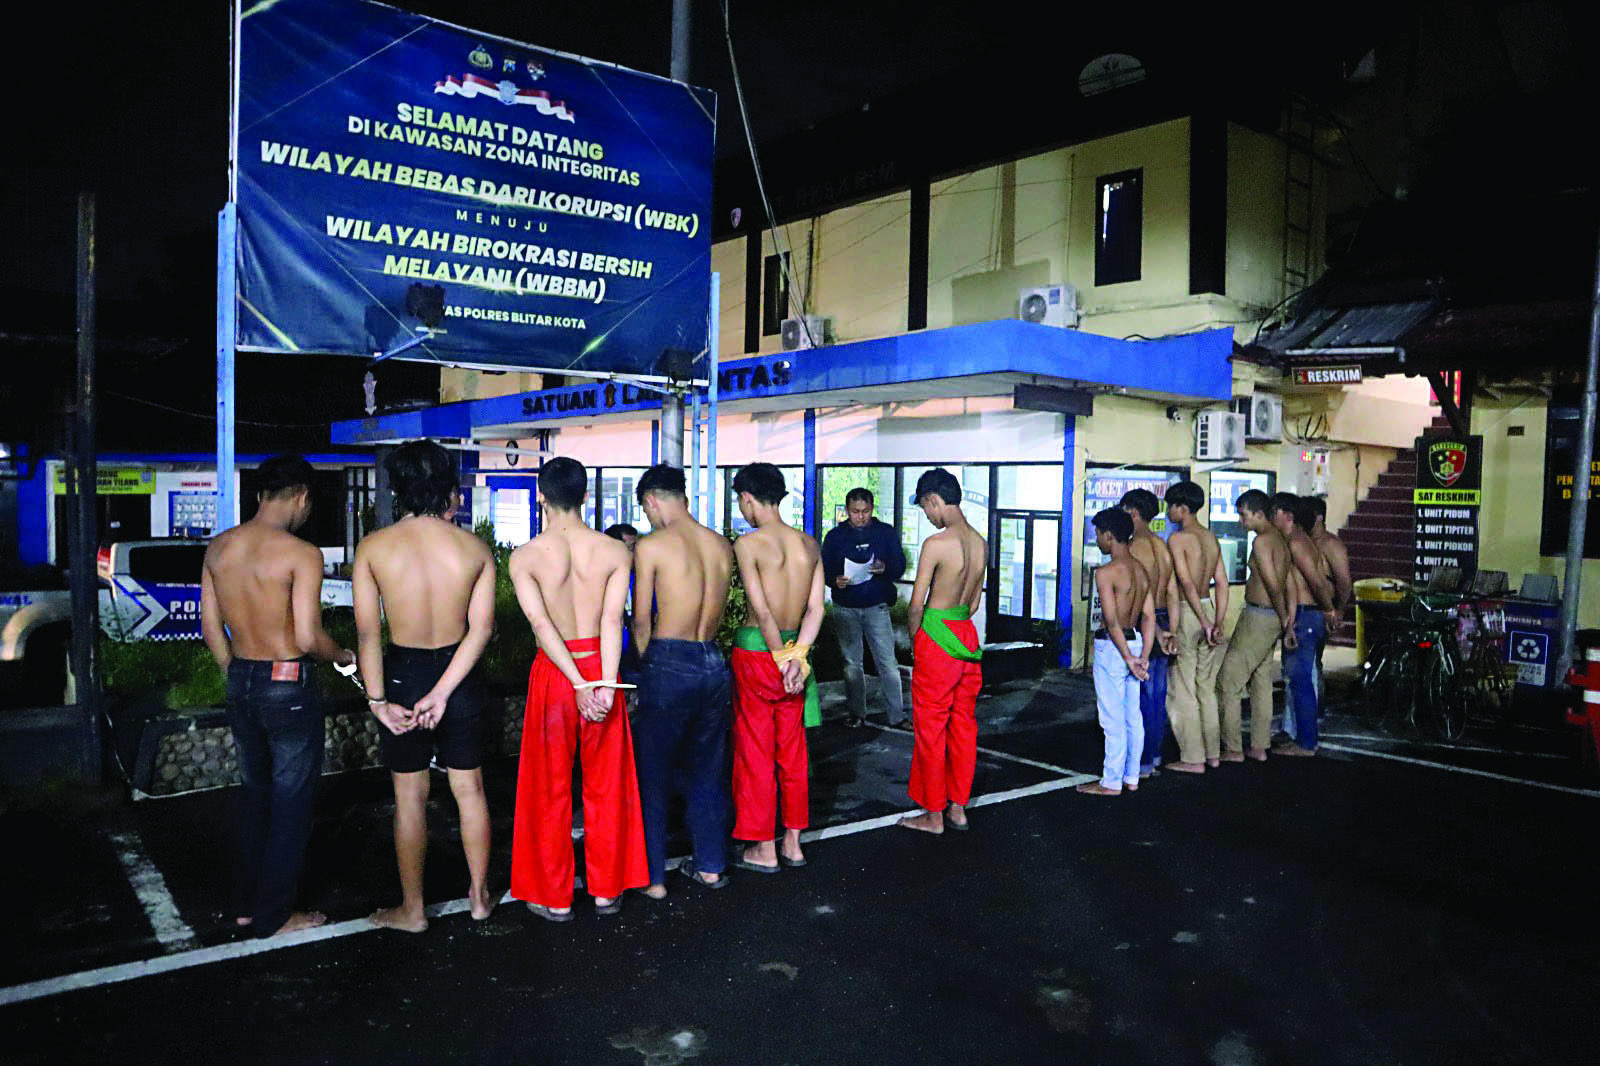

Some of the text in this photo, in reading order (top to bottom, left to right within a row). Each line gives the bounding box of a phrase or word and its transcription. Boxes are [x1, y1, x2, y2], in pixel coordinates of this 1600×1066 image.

[397, 102, 604, 161] SELAMAT DATANG
[348, 115, 641, 187] DI KAWASAN ZONA INTEGRITAS
[261, 140, 699, 239] WILAYAH BEBAS DARI KORUPSI (WBK)
[456, 209, 548, 233] MENUJU
[326, 215, 653, 280] WILAYAH BIROKRASI BERSIH
[384, 255, 606, 304] MELAYANI (WBBM)
[442, 305, 587, 330] AS POLRES BLITAR KOTA
[1308, 368, 1360, 383] RESKRIM
[522, 388, 597, 416] SATUAN
[1086, 480, 1123, 498] LOKET
[1418, 491, 1476, 502] SAT RESKRIM
[1424, 508, 1442, 518] UNIT
[1443, 509, 1470, 519] PIDUM
[1425, 524, 1443, 534] UNIT
[1424, 540, 1442, 551] UNIT
[1423, 556, 1442, 567] UNIT
[1443, 557, 1458, 567] PPA
